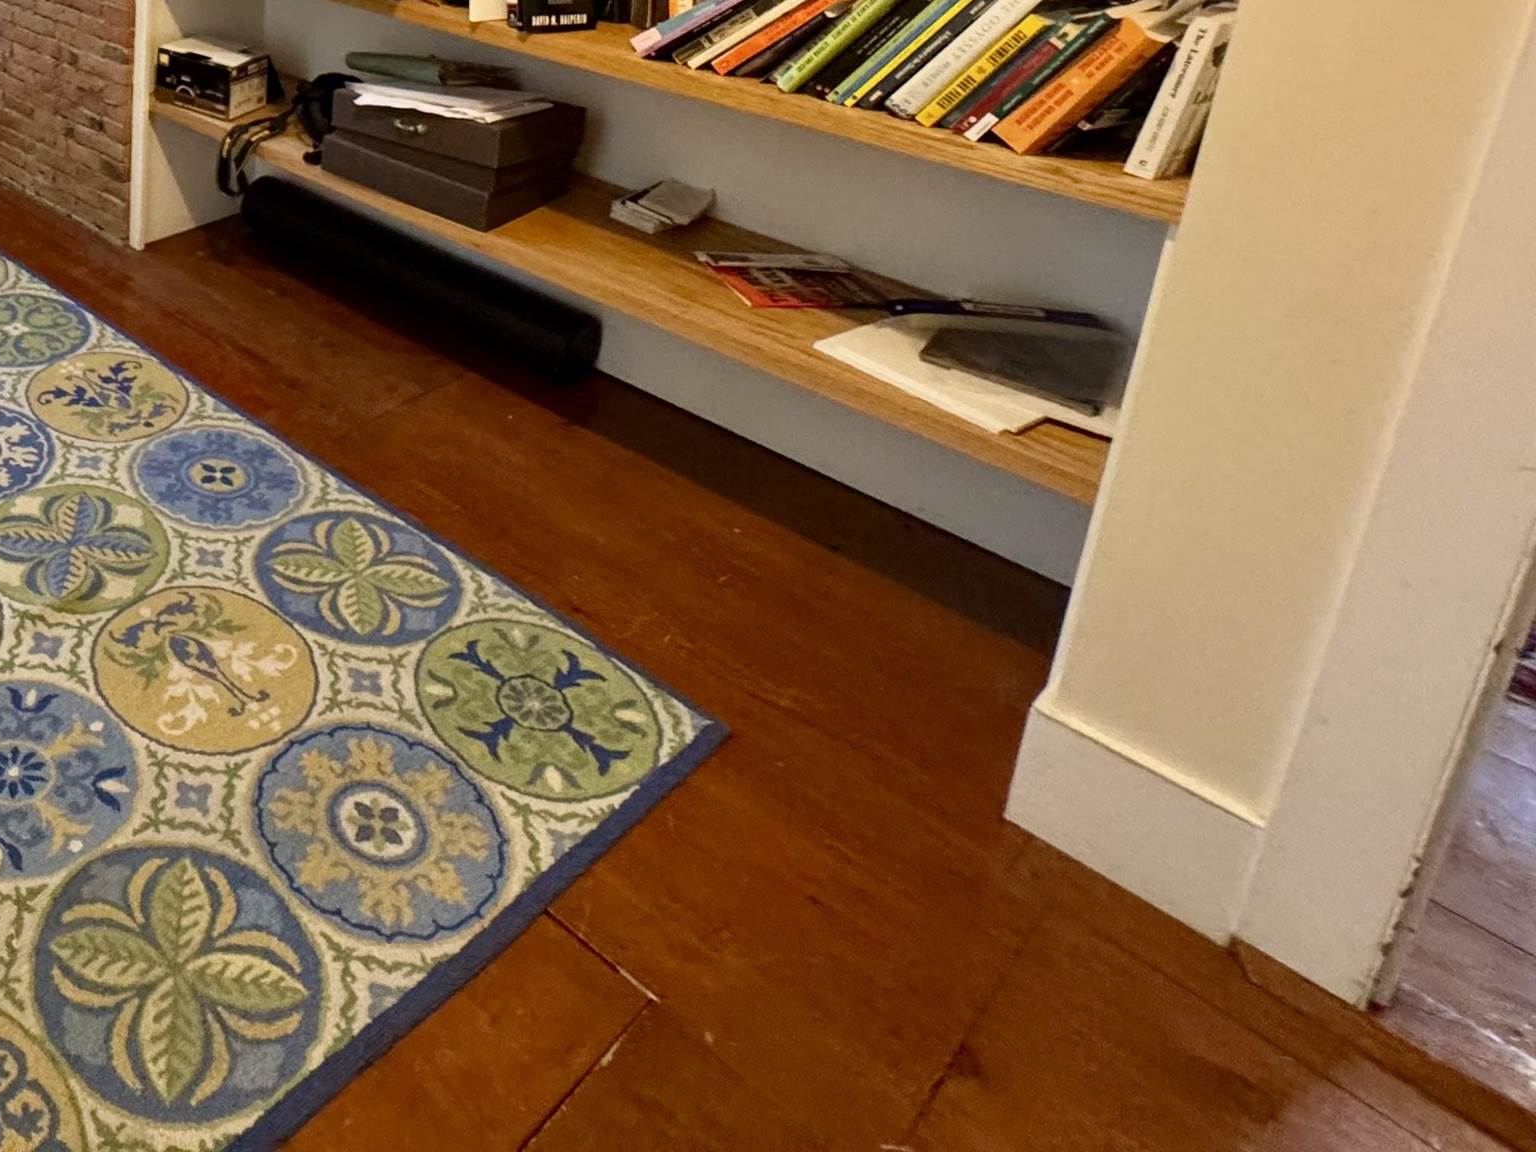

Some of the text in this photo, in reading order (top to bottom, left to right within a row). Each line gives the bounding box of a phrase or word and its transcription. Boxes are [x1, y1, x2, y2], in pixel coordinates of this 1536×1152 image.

[531, 15, 551, 27] DAVID
[559, 13, 588, 26] HALPERIN
[951, 14, 1001, 60] ODYSSEY
[986, 27, 1029, 68] CONTAINMENT
[1167, 27, 1209, 100] The Latecomer
